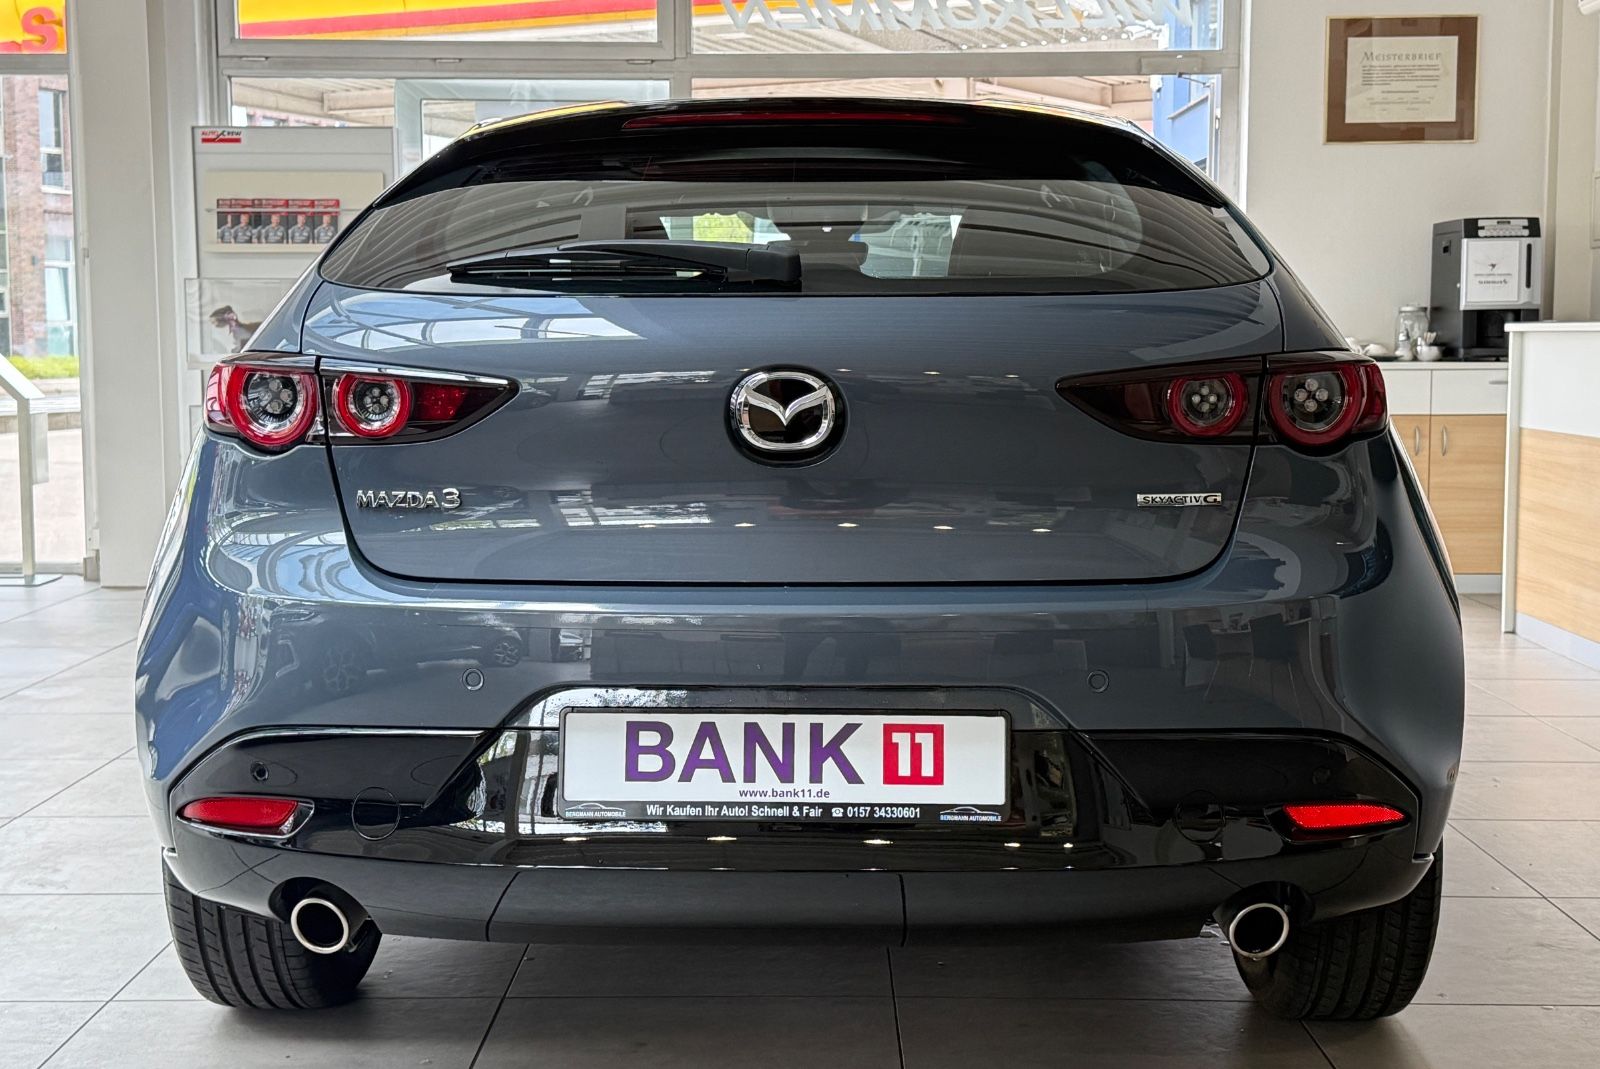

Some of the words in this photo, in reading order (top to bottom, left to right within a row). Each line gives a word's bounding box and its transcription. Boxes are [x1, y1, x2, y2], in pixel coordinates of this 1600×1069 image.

[624, 720, 865, 785] BANK
[891, 731, 935, 778] 11
[738, 787, 830, 799] www.bank11.de
[646, 804, 664, 816] Wir
[666, 804, 703, 816] Kaufen
[705, 804, 719, 816] Ihr
[751, 805, 790, 817] Schnell
[792, 806, 800, 817] &
[802, 805, 823, 818] Fair
[847, 806, 870, 818] 0157
[873, 806, 921, 819] 34330601
